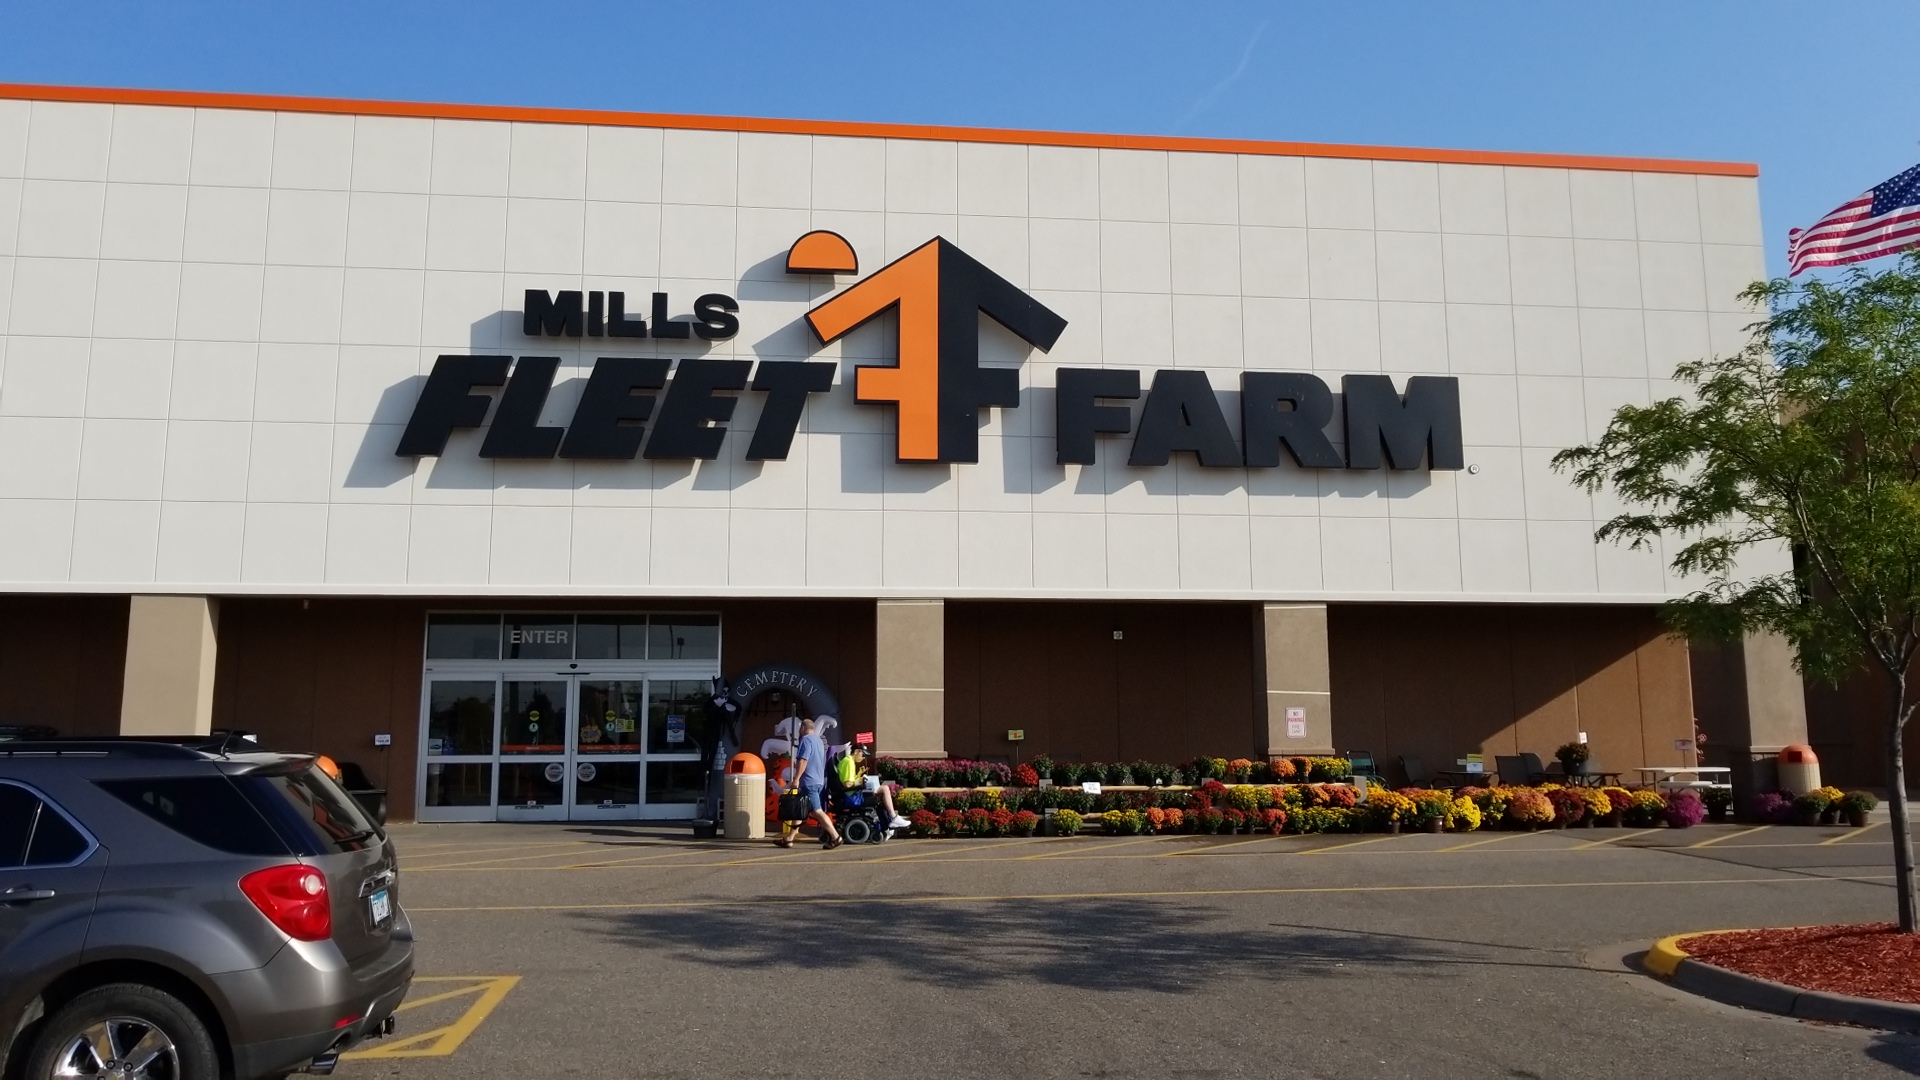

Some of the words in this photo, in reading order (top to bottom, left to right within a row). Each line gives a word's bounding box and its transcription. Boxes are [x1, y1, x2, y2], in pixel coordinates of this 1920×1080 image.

[523, 289, 740, 340] MILLS
[395, 354, 838, 462] FLEET
[1055, 367, 1465, 471] FARM
[510, 630, 569, 645] ENTER
[736, 670, 818, 697] CEMETERY
